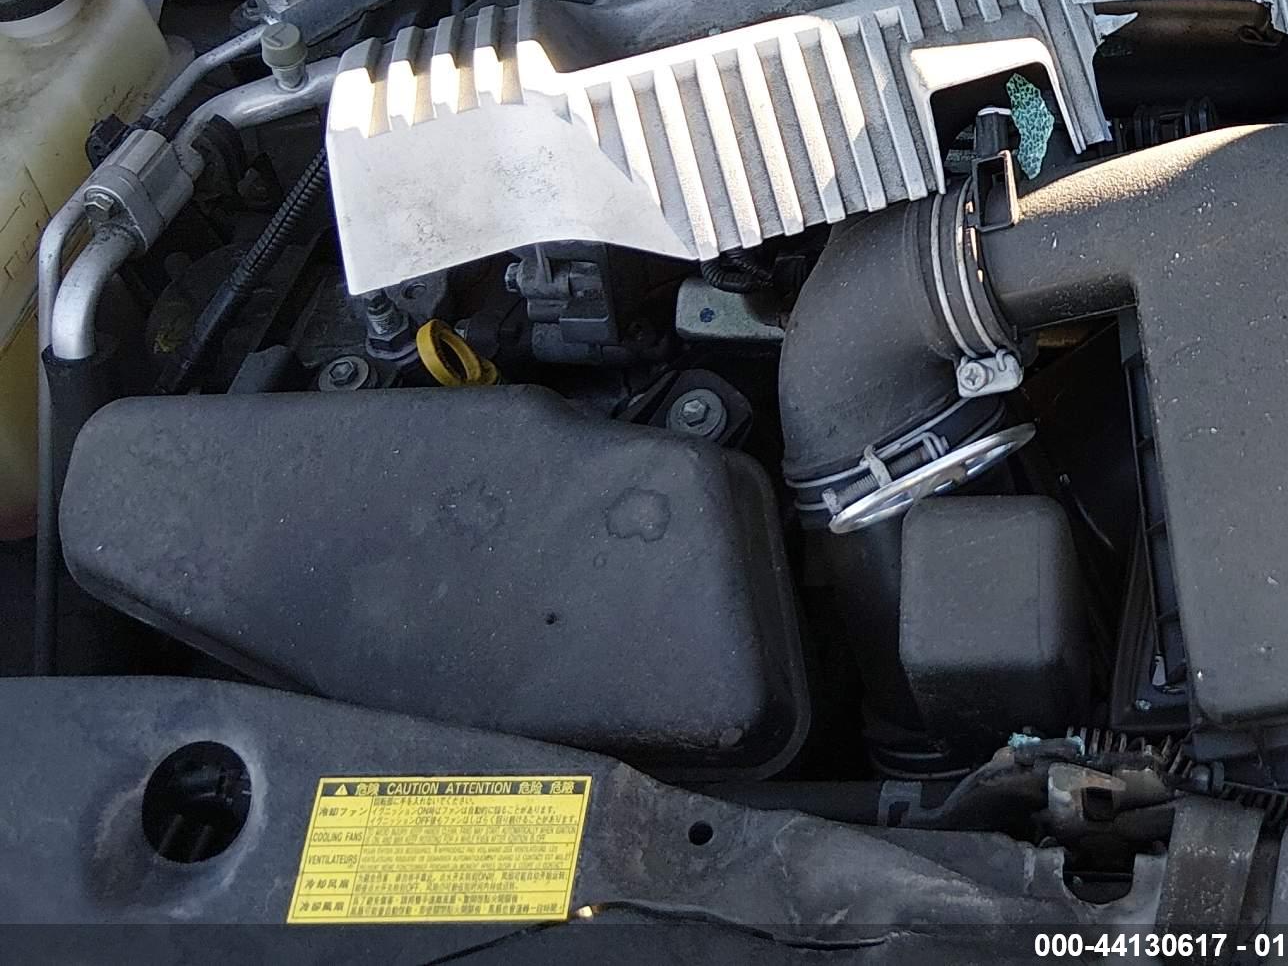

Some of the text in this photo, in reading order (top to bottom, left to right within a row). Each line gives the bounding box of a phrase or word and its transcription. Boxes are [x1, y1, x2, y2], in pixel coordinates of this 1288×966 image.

[386, 782, 511, 795] CAUTION ATTENTION
[312, 832, 342, 842] COOLING
[345, 831, 363, 842] FANS
[308, 854, 358, 865] VENTILATEURS
